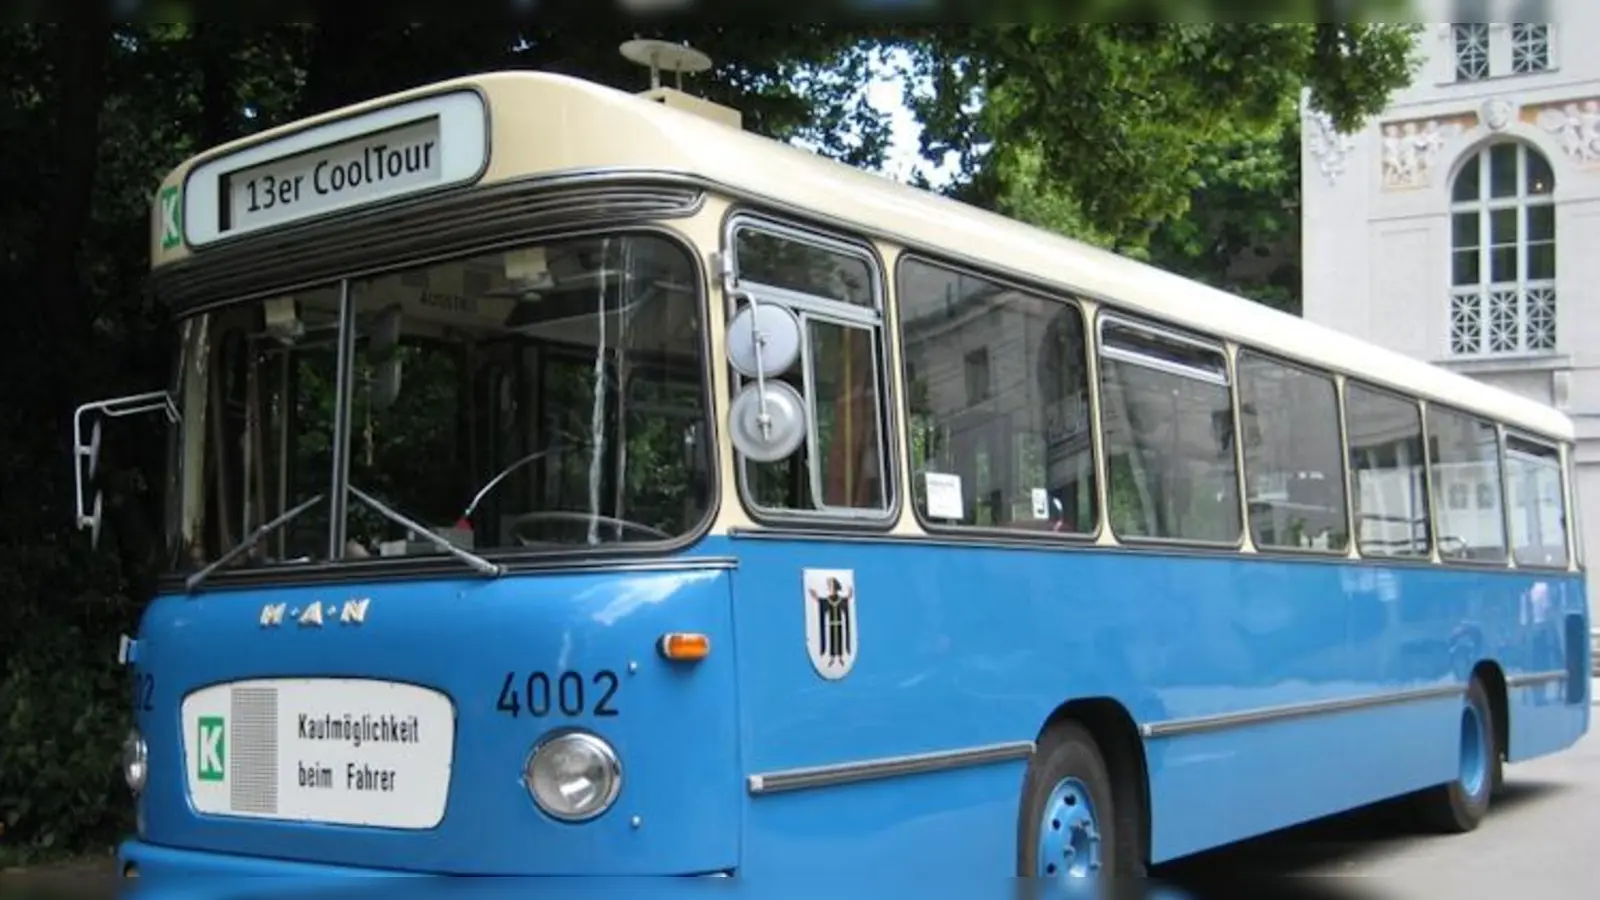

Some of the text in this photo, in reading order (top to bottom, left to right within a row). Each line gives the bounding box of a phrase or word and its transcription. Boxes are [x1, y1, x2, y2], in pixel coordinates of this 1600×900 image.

[245, 140, 435, 213] 13er CoolTour
[495, 670, 620, 719] 4002
[200, 724, 224, 774] K
[298, 713, 419, 748] Kaufmöglichkeit
[298, 760, 396, 792] beim Fahrer
